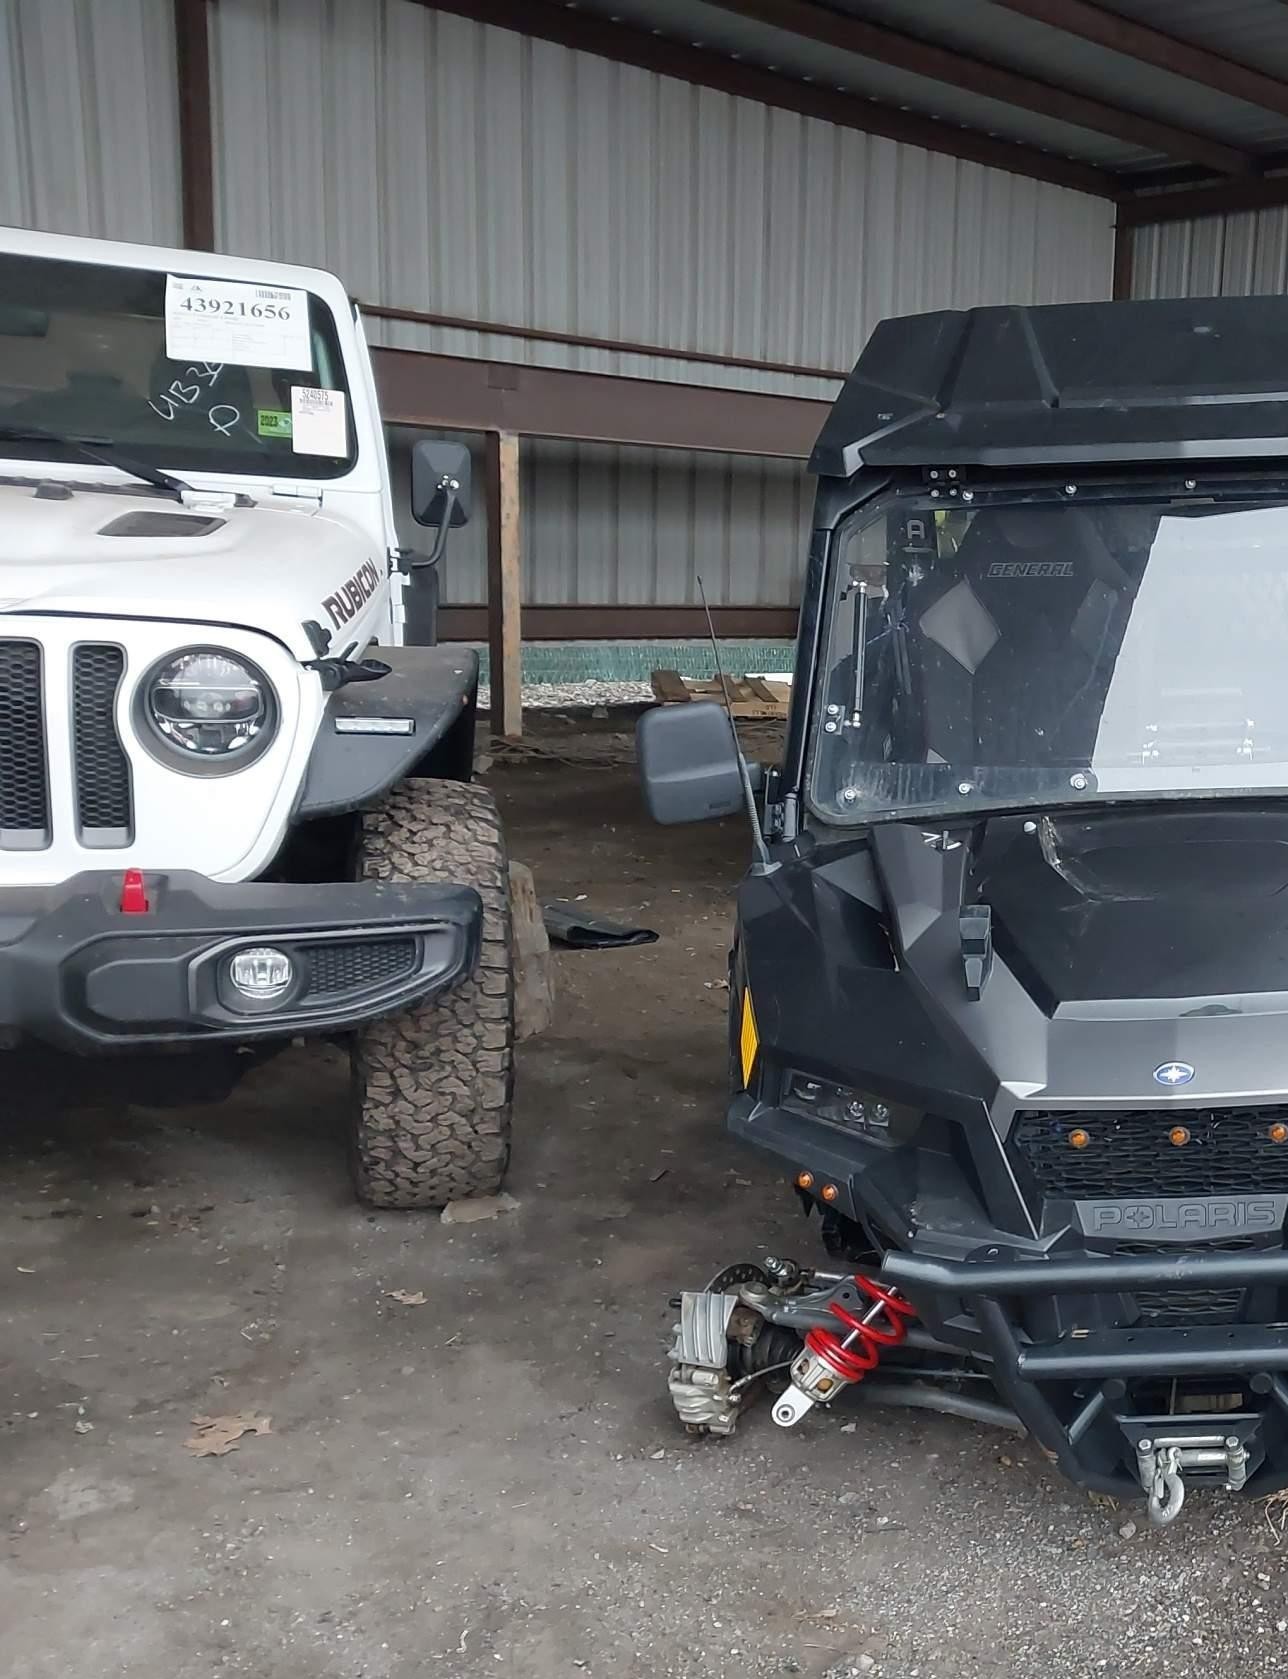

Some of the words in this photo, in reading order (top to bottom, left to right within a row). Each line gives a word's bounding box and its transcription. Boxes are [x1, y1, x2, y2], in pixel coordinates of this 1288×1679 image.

[180, 297, 291, 321] 43921656
[260, 415, 279, 427] 2023
[987, 562, 1075, 577] GENERAL
[321, 557, 379, 630] RUBICON
[1093, 1201, 1276, 1231] POLARIS
